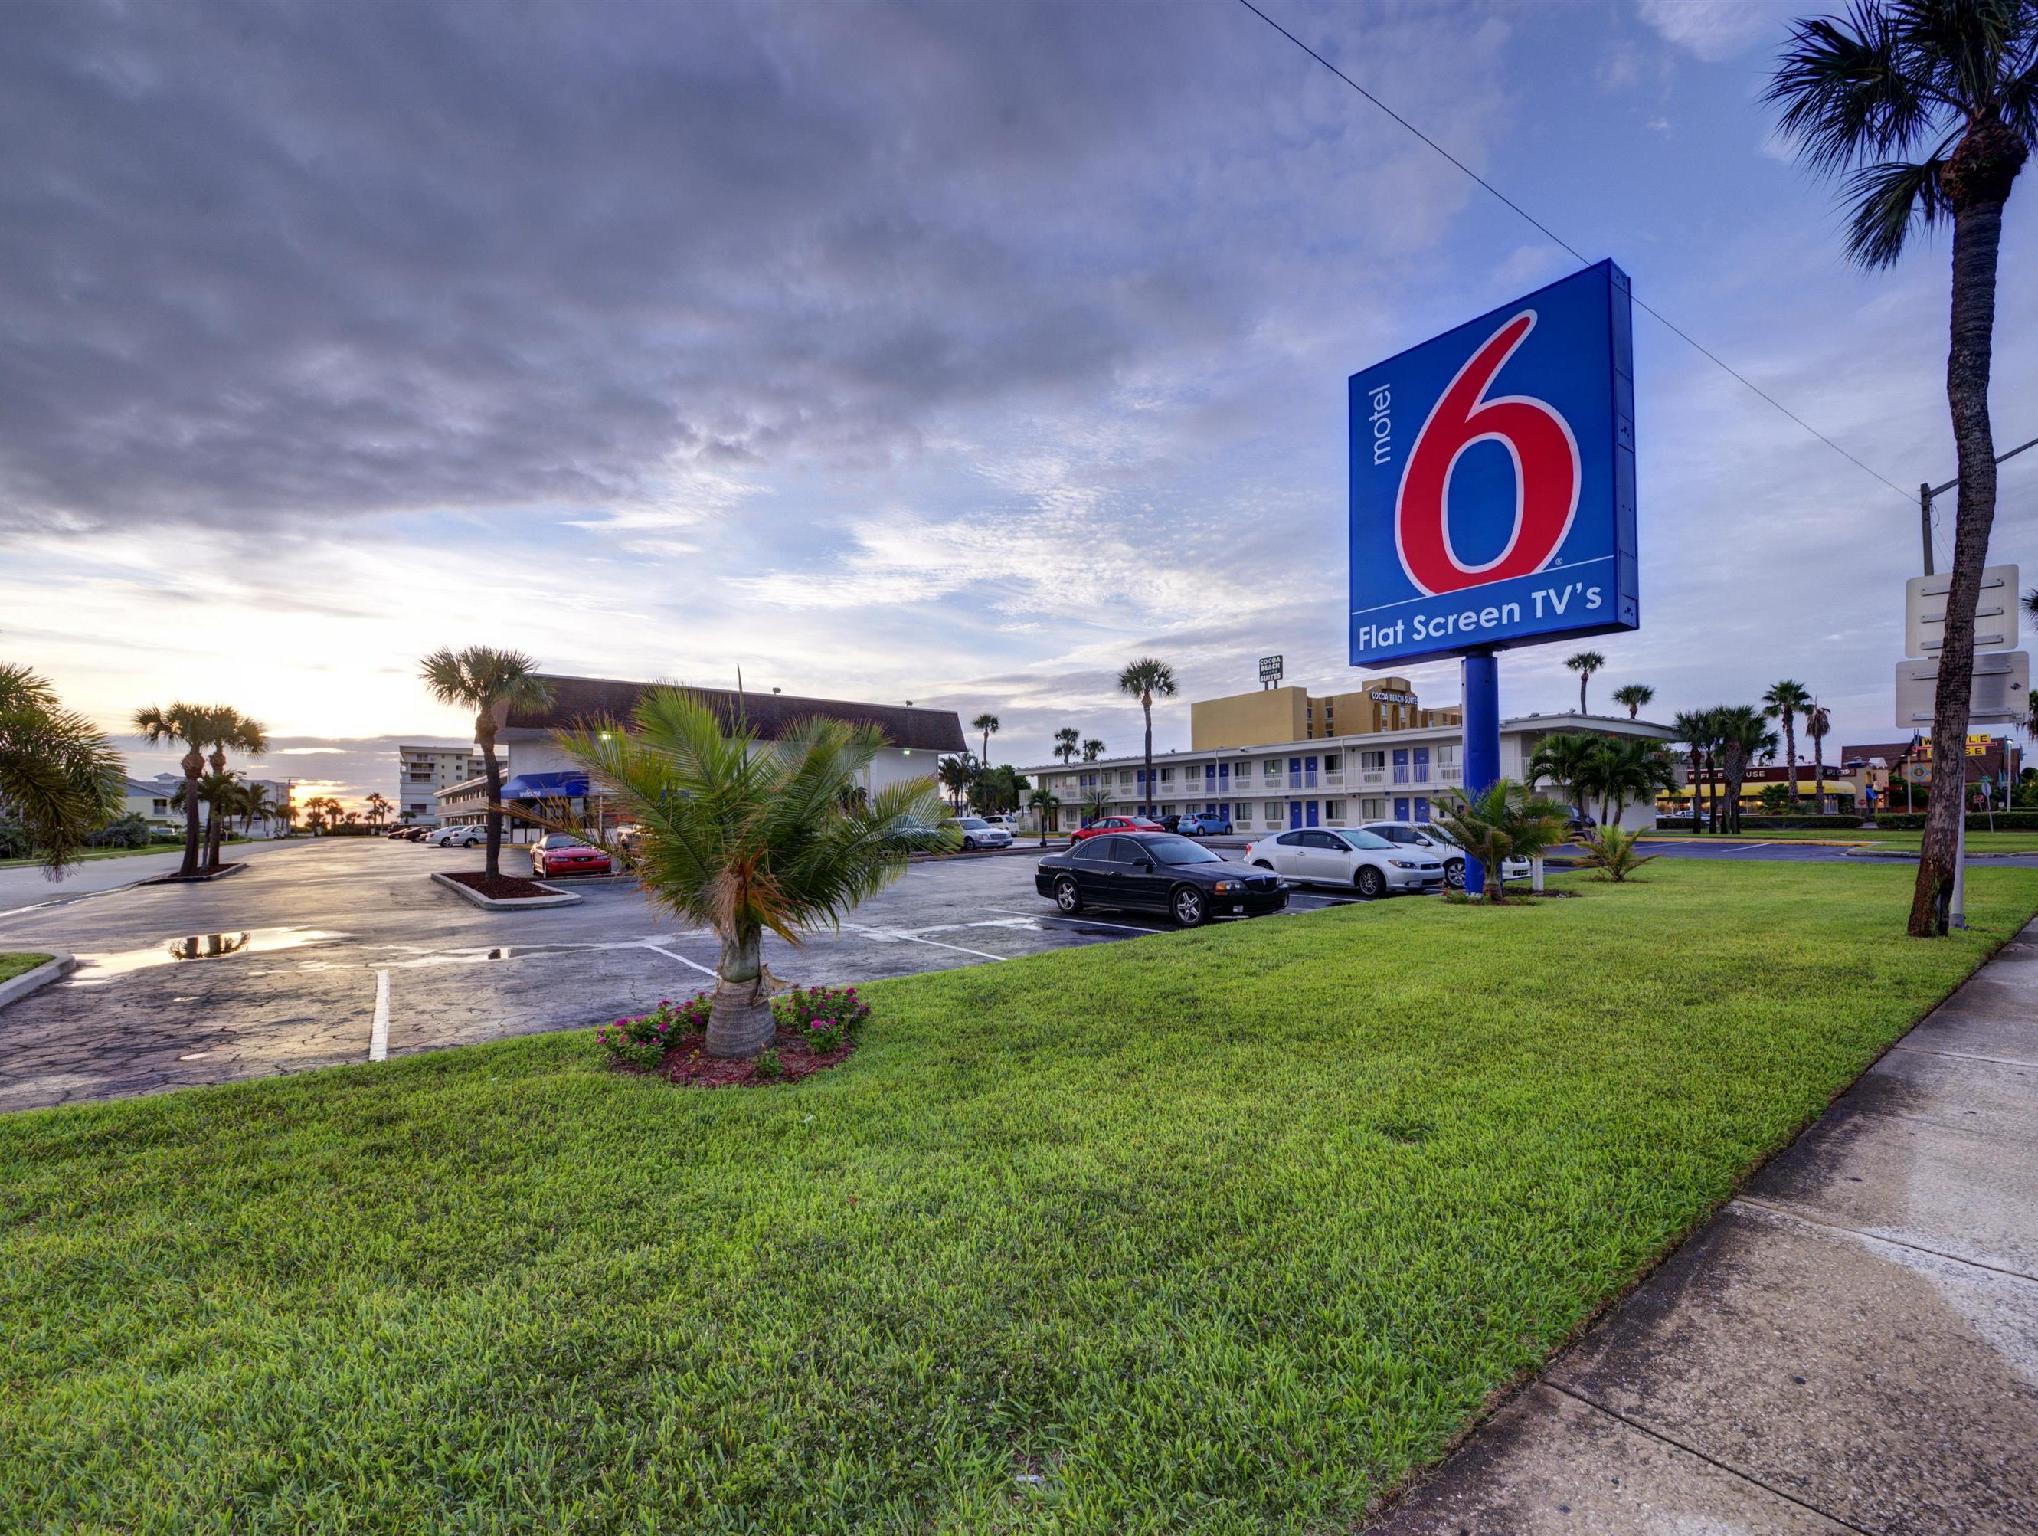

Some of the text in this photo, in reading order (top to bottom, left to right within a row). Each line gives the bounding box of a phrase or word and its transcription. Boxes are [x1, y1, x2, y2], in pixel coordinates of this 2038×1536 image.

[1368, 384, 1391, 466] motel
[1395, 309, 1582, 597] 6
[1359, 582, 1602, 650] Flat Screen TV's
[1260, 656, 1281, 665] COCOA
